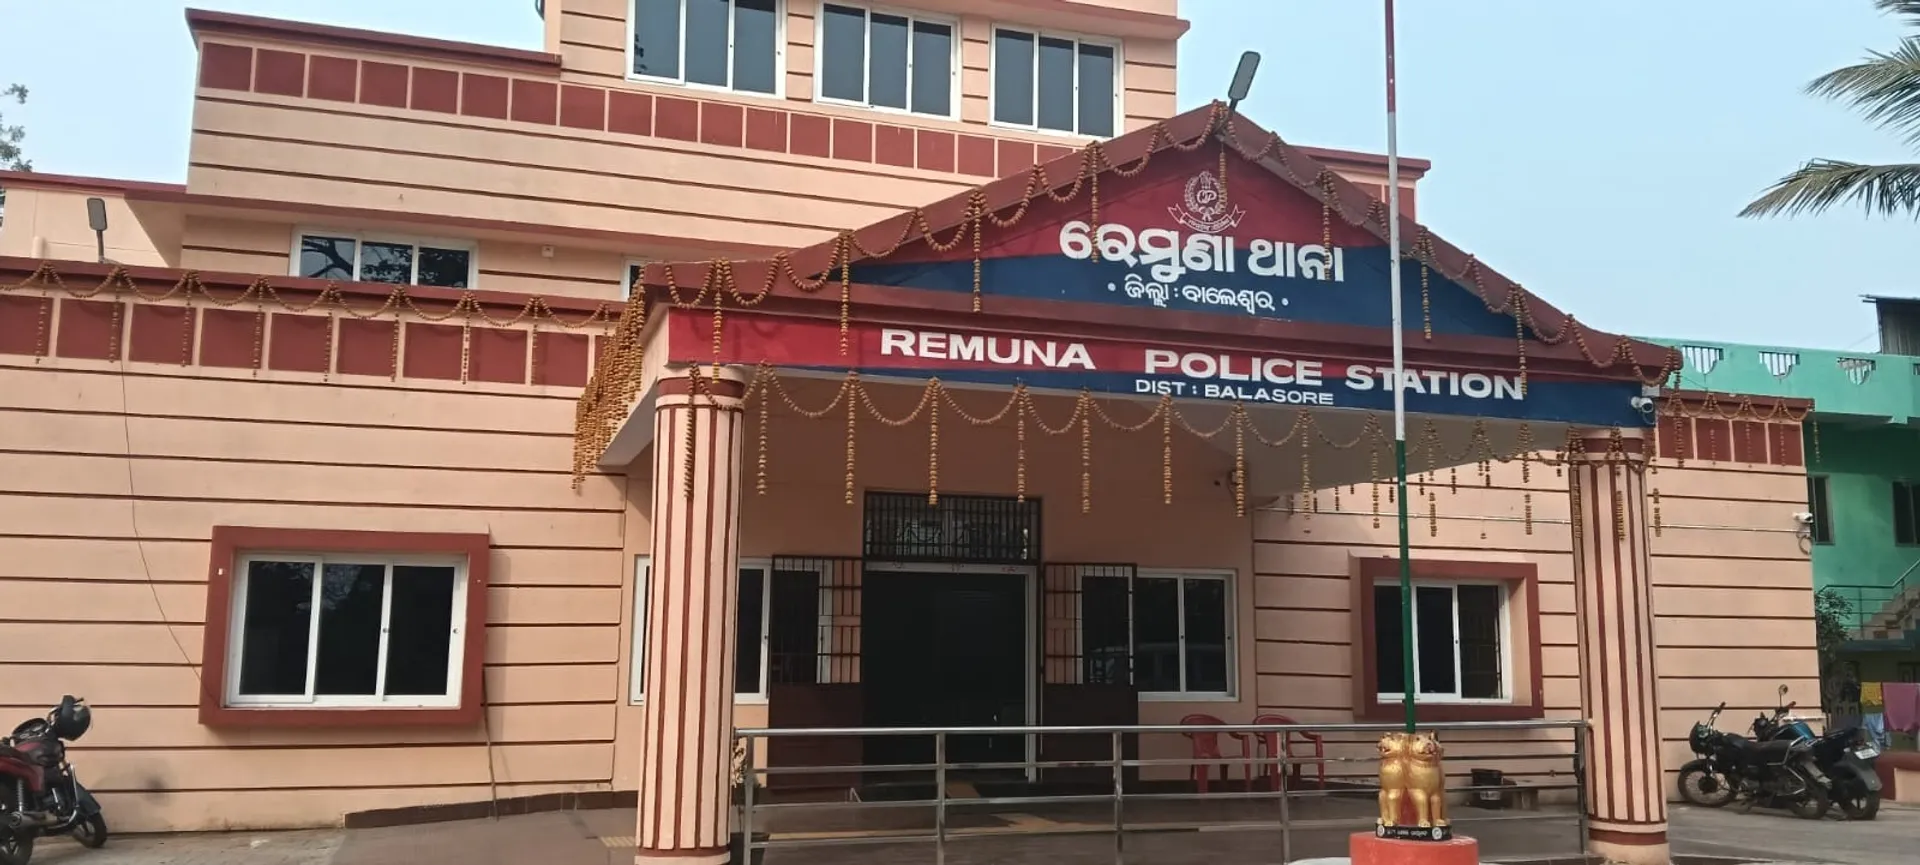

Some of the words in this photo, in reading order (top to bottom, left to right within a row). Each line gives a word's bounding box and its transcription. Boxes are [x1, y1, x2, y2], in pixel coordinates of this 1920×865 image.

[1059, 220, 1235, 283] ରେମୁଣା
[1247, 238, 1345, 282] ଥାନା
[881, 328, 1096, 370] REMUNA
[1144, 348, 1323, 386] POLICE
[1345, 364, 1525, 401] STATION
[1135, 379, 1186, 396] DIST
[1204, 384, 1334, 406] BALASORE
